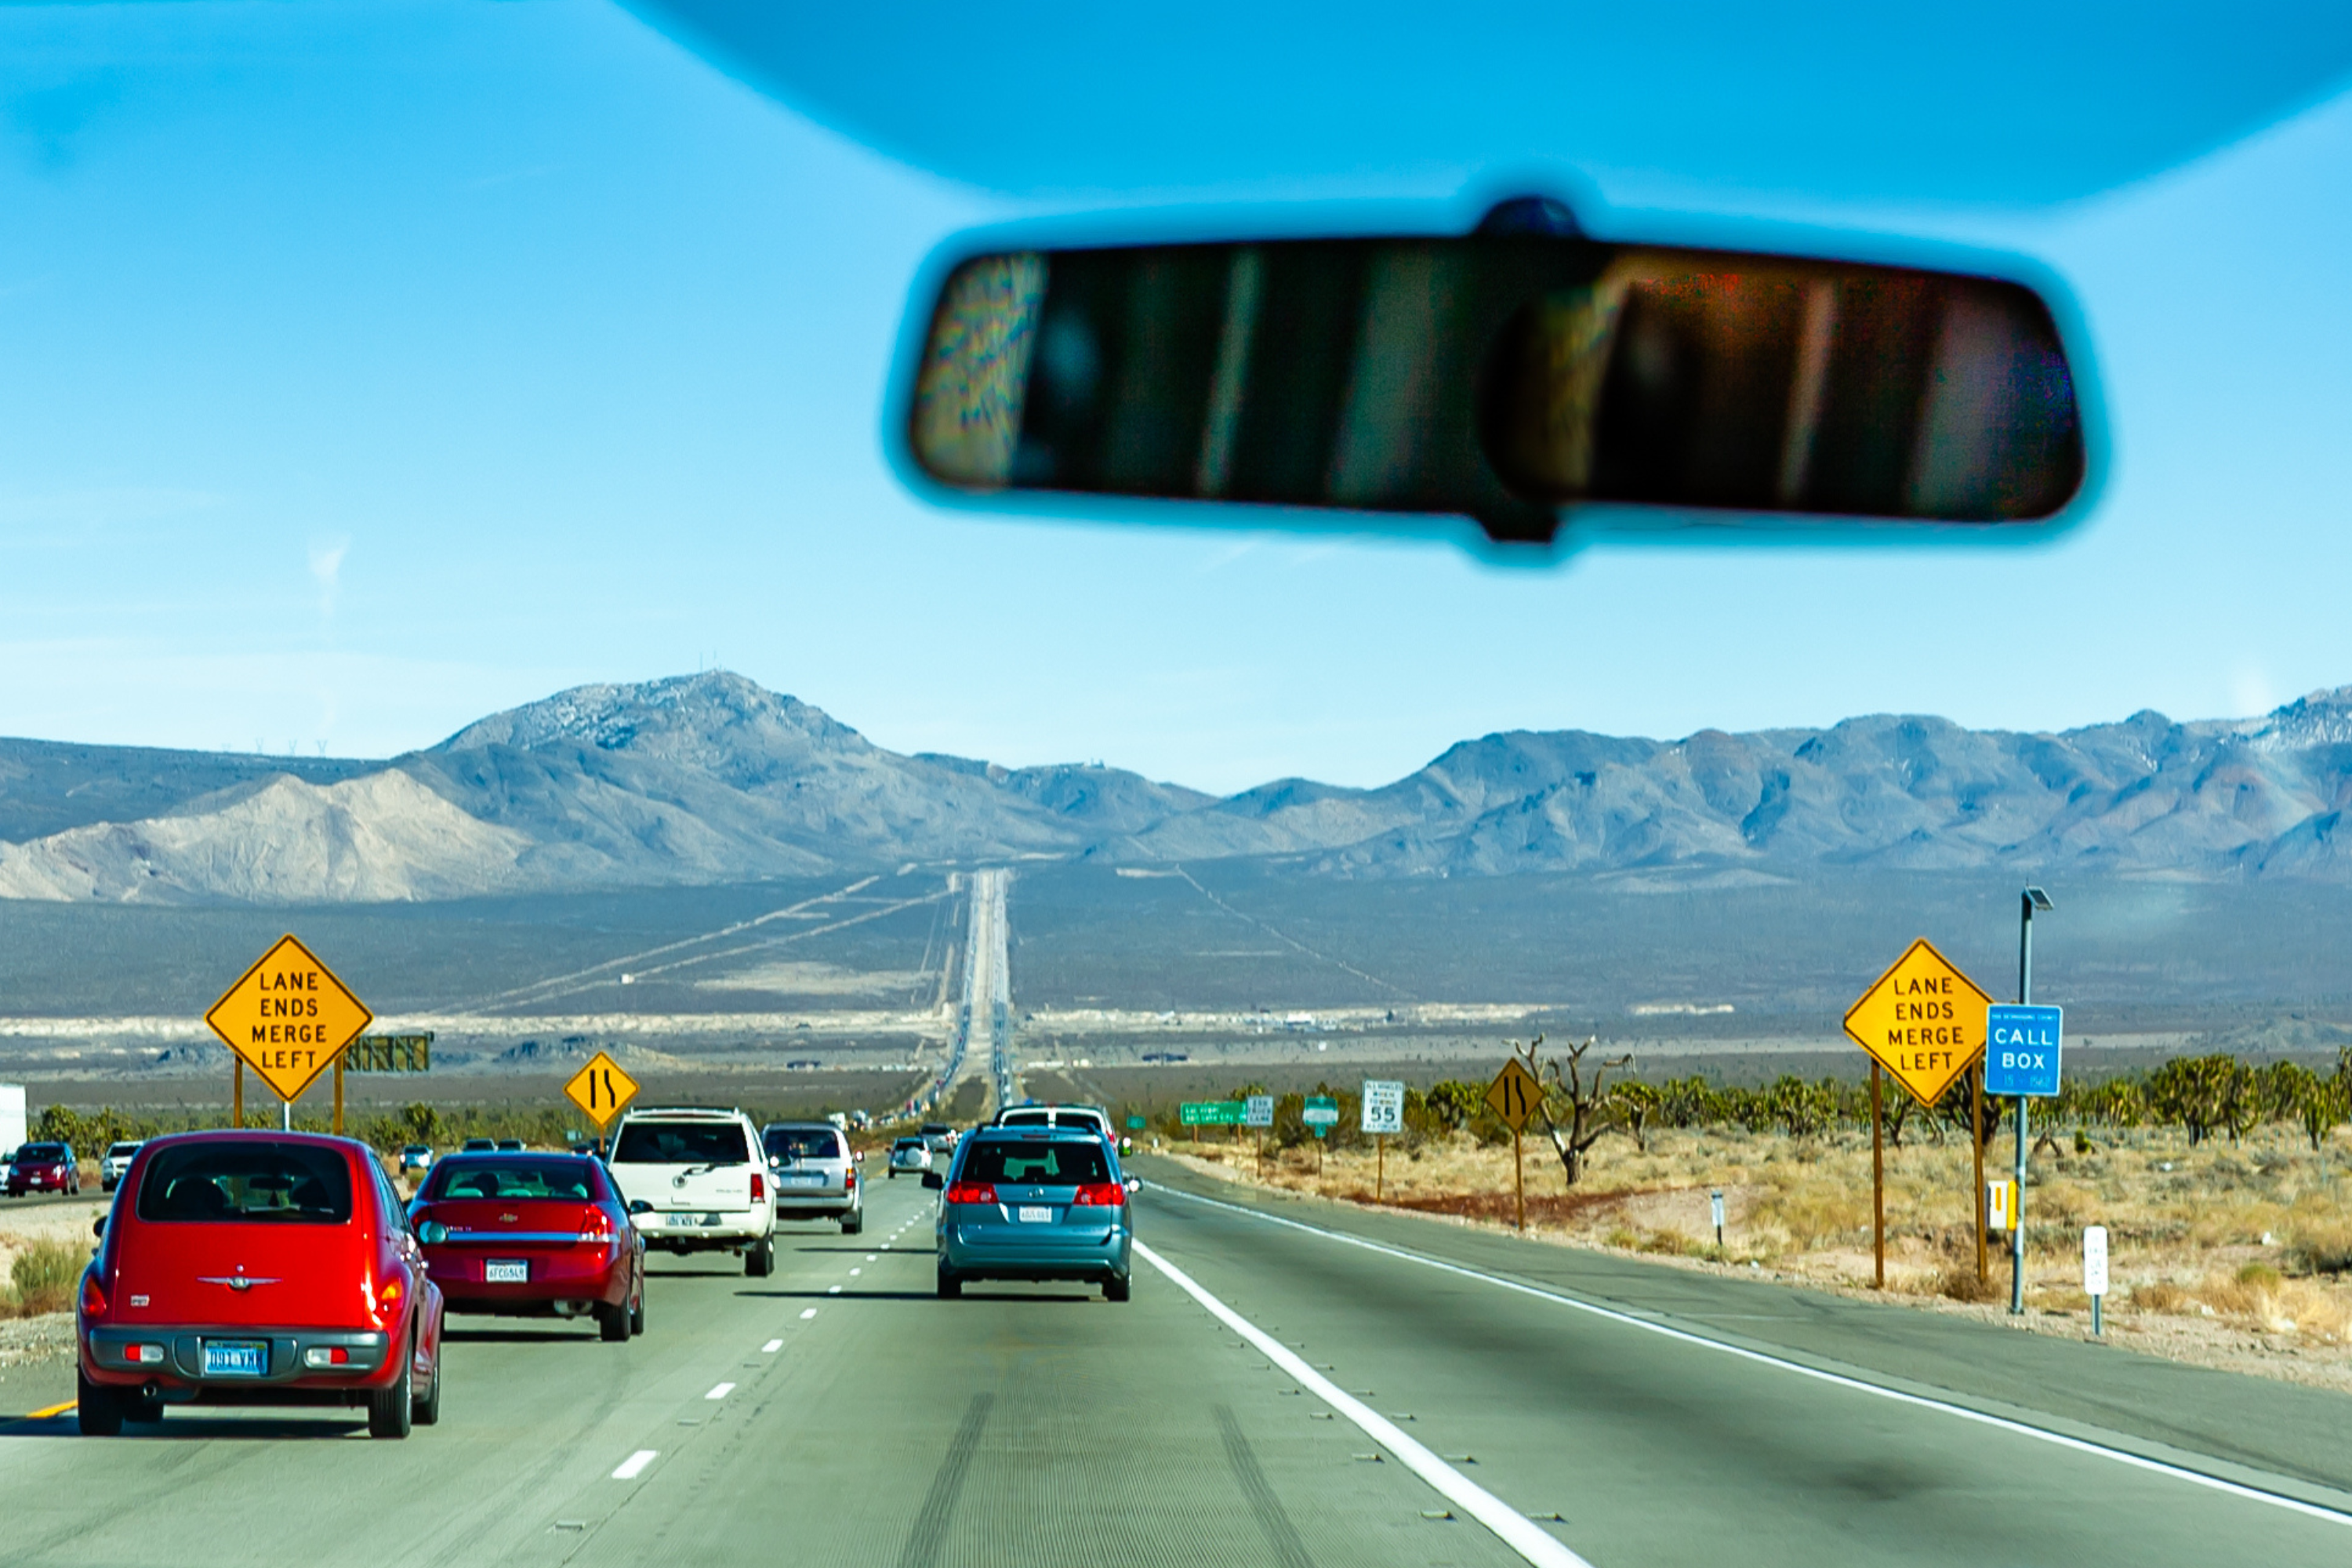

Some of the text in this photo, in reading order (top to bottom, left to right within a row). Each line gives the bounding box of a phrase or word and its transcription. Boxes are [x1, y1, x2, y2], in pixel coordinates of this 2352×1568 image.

[260, 971, 318, 990] LANE
[1894, 977, 1953, 995] LANE
[260, 998, 318, 1017] ENDS
[1896, 1000, 1954, 1020] ENDS
[252, 1024, 327, 1043] MERGE
[1888, 1026, 1963, 1046] MERGE
[1994, 1028, 2053, 1047] CALL
[262, 1051, 316, 1069] LEFT
[1900, 1052, 1953, 1070] LEFT
[2002, 1052, 2045, 1070] BOX
[1370, 1106, 1396, 1123] 55
